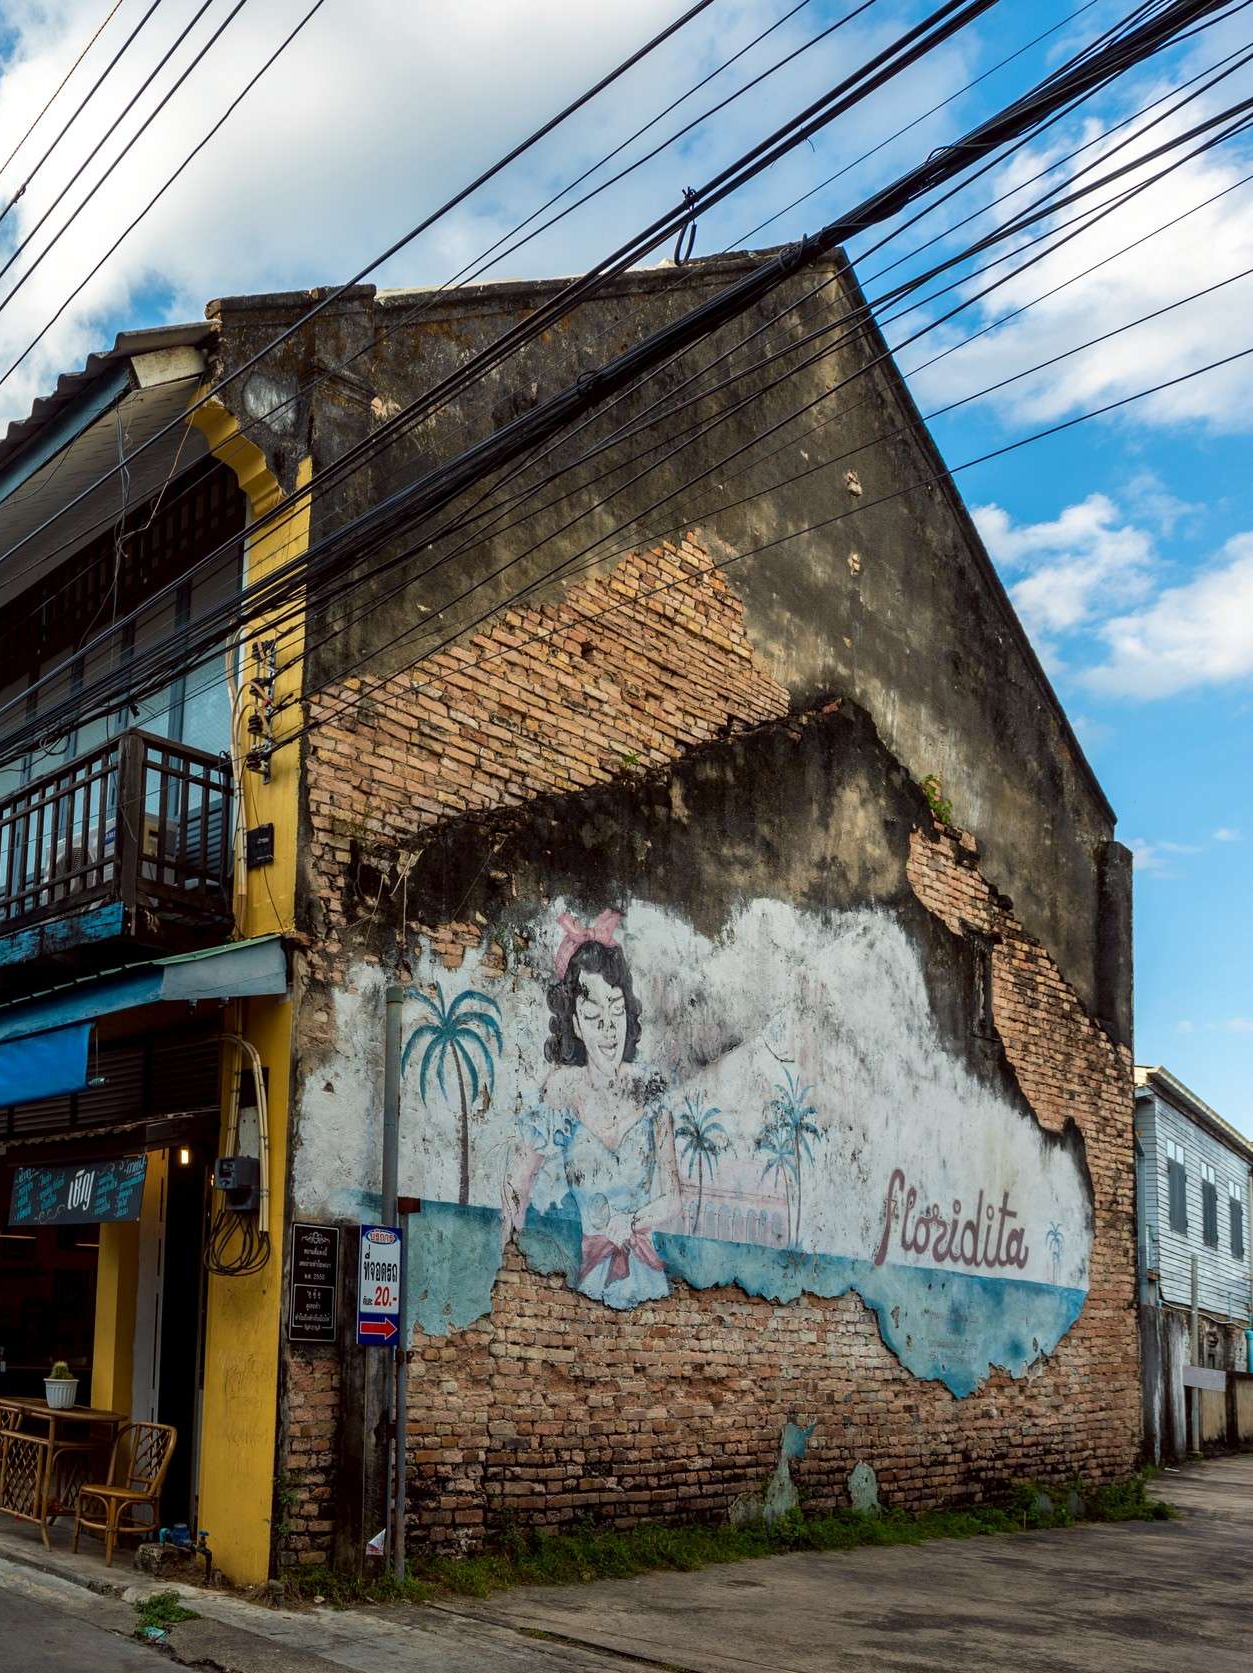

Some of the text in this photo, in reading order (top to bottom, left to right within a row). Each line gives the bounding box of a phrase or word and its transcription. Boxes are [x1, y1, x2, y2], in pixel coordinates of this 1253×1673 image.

[370, 1228, 395, 1243] บริการ
[363, 1245, 398, 1282] ที่จอดรถ
